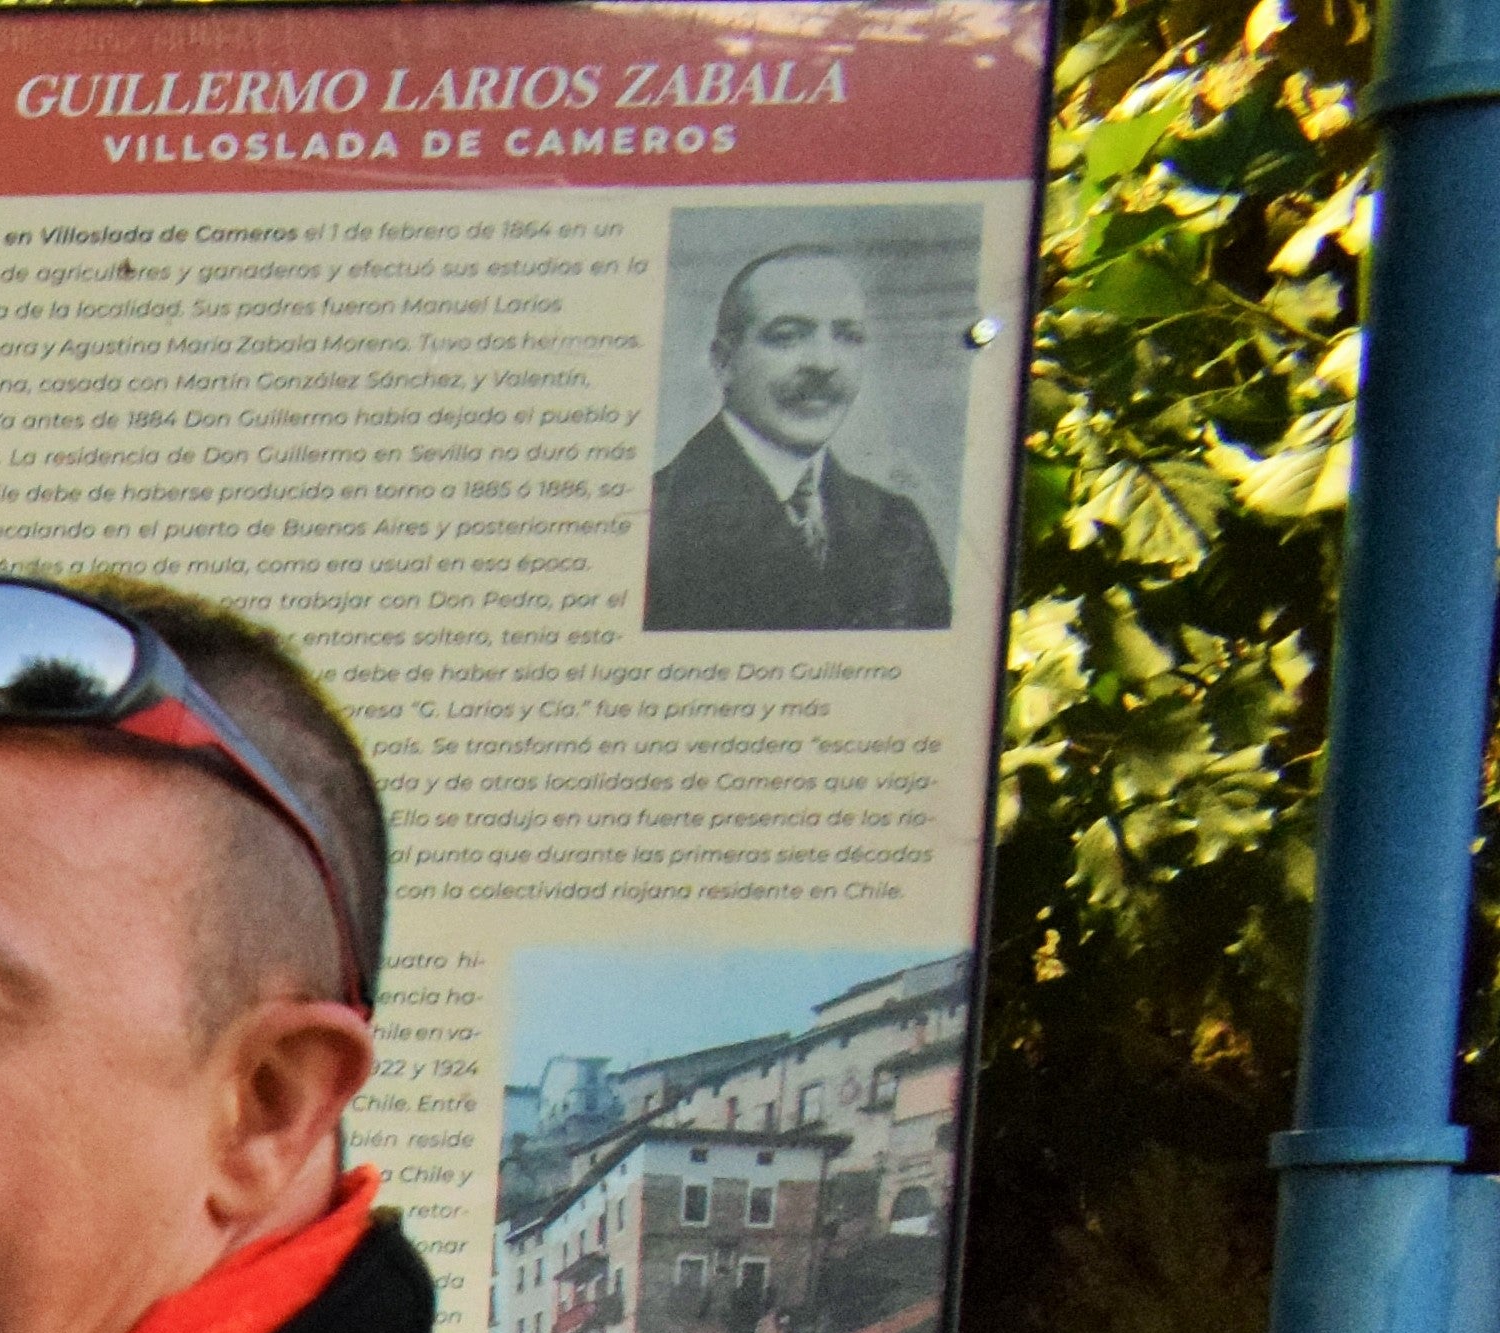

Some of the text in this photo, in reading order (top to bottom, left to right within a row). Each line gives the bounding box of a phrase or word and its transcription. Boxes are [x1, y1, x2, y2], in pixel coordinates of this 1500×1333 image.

[15, 58, 848, 118] GUILLERMO LARIOS ZABALA
[103, 122, 739, 163] VILLOSLADA DE CAMEROS
[39, 225, 154, 245] Villoslada
[194, 224, 299, 243] Cameros
[378, 222, 460, 242] febrero
[502, 221, 552, 240] 1864
[198, 259, 322, 284] ganaderos
[348, 258, 436, 277] efectuó
[442, 263, 480, 277] sus
[486, 256, 584, 276] estudios
[191, 297, 232, 316] Sus
[236, 296, 317, 321] padres
[321, 295, 396, 315] fueron
[401, 294, 489, 314] Manuel
[494, 293, 564, 313] Larios
[59, 335, 162, 360] Agustina
[166, 334, 233, 354] María
[236, 334, 318, 353] Zabala
[419, 332, 473, 351] Tuvo
[476, 331, 518, 351] dos
[39, 372, 123, 391] casada
[127, 377, 170, 391] con
[175, 371, 251, 390] Martín
[256, 370, 360, 390] González
[21, 410, 86, 429] antes
[127, 409, 178, 429] 1884
[184, 409, 232, 428] Don
[237, 408, 349, 427] Guillermo
[354, 407, 422, 427] había
[427, 406, 508, 431] dejado
[539, 406, 620, 430] pueblo
[164, 519, 240, 544] puerto
[282, 518, 368, 538] Buenos
[373, 518, 430, 537] Aires
[456, 517, 632, 541] posteriormente
[343, 663, 401, 682] debe
[439, 662, 508, 682] haber
[513, 662, 561, 681] sido
[591, 662, 652, 686] lugar
[657, 661, 731, 681] donde
[736, 661, 785, 680] Don
[790, 660, 903, 680] Guillermo
[397, 885, 437, 899] con
[468, 880, 608, 899] colectividad
[612, 879, 693, 904] riojana
[698, 879, 804, 899] residente
